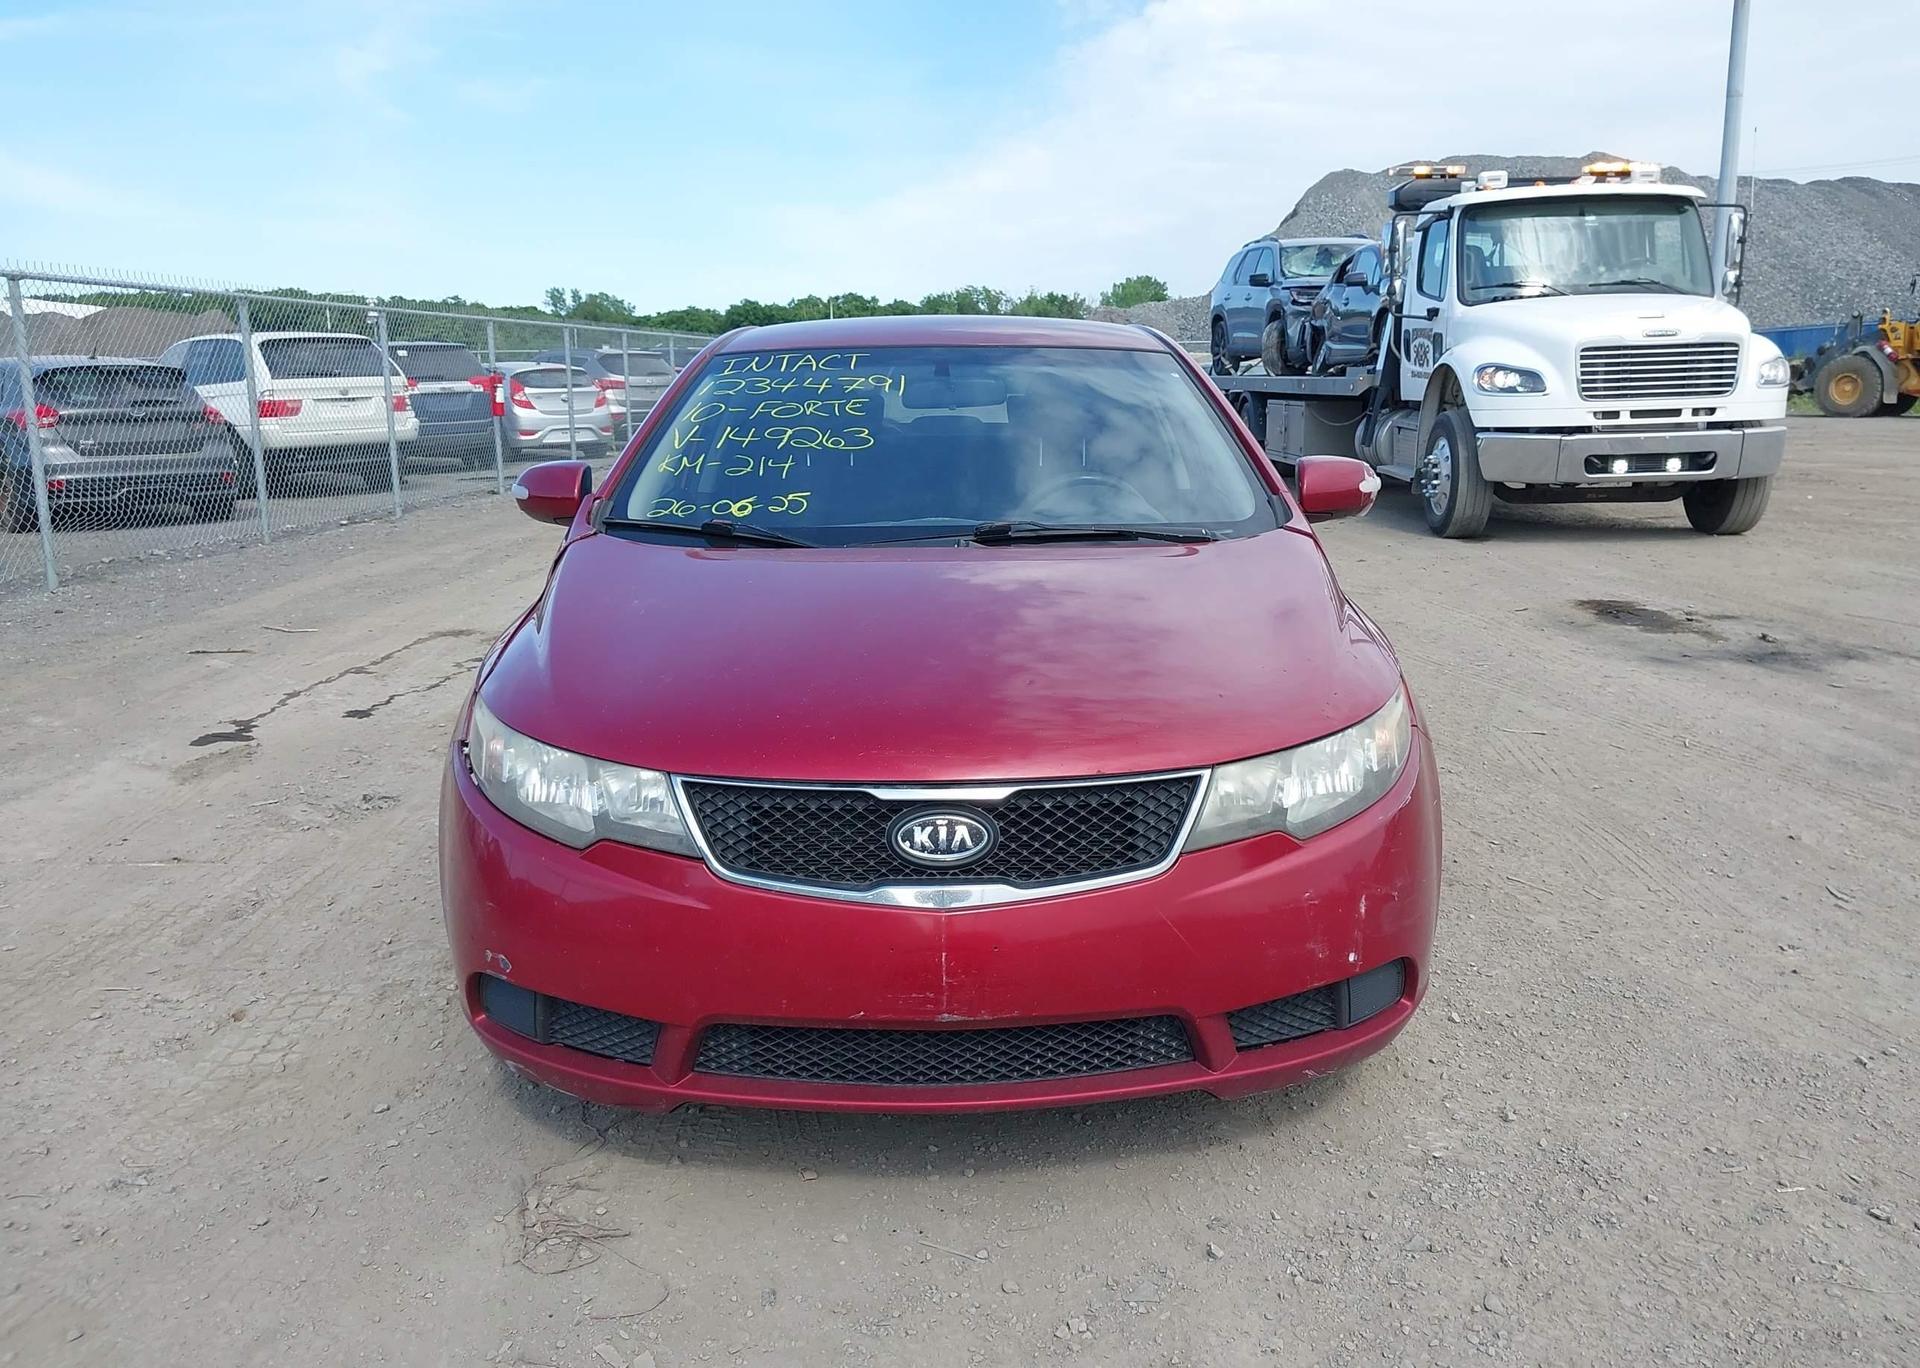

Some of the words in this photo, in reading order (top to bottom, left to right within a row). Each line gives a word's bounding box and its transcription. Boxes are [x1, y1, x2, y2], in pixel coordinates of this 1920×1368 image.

[716, 353, 870, 376] INTACT
[698, 374, 905, 397] 12344791
[646, 492, 811, 518] 26-06-25
[912, 819, 974, 851] KIA
